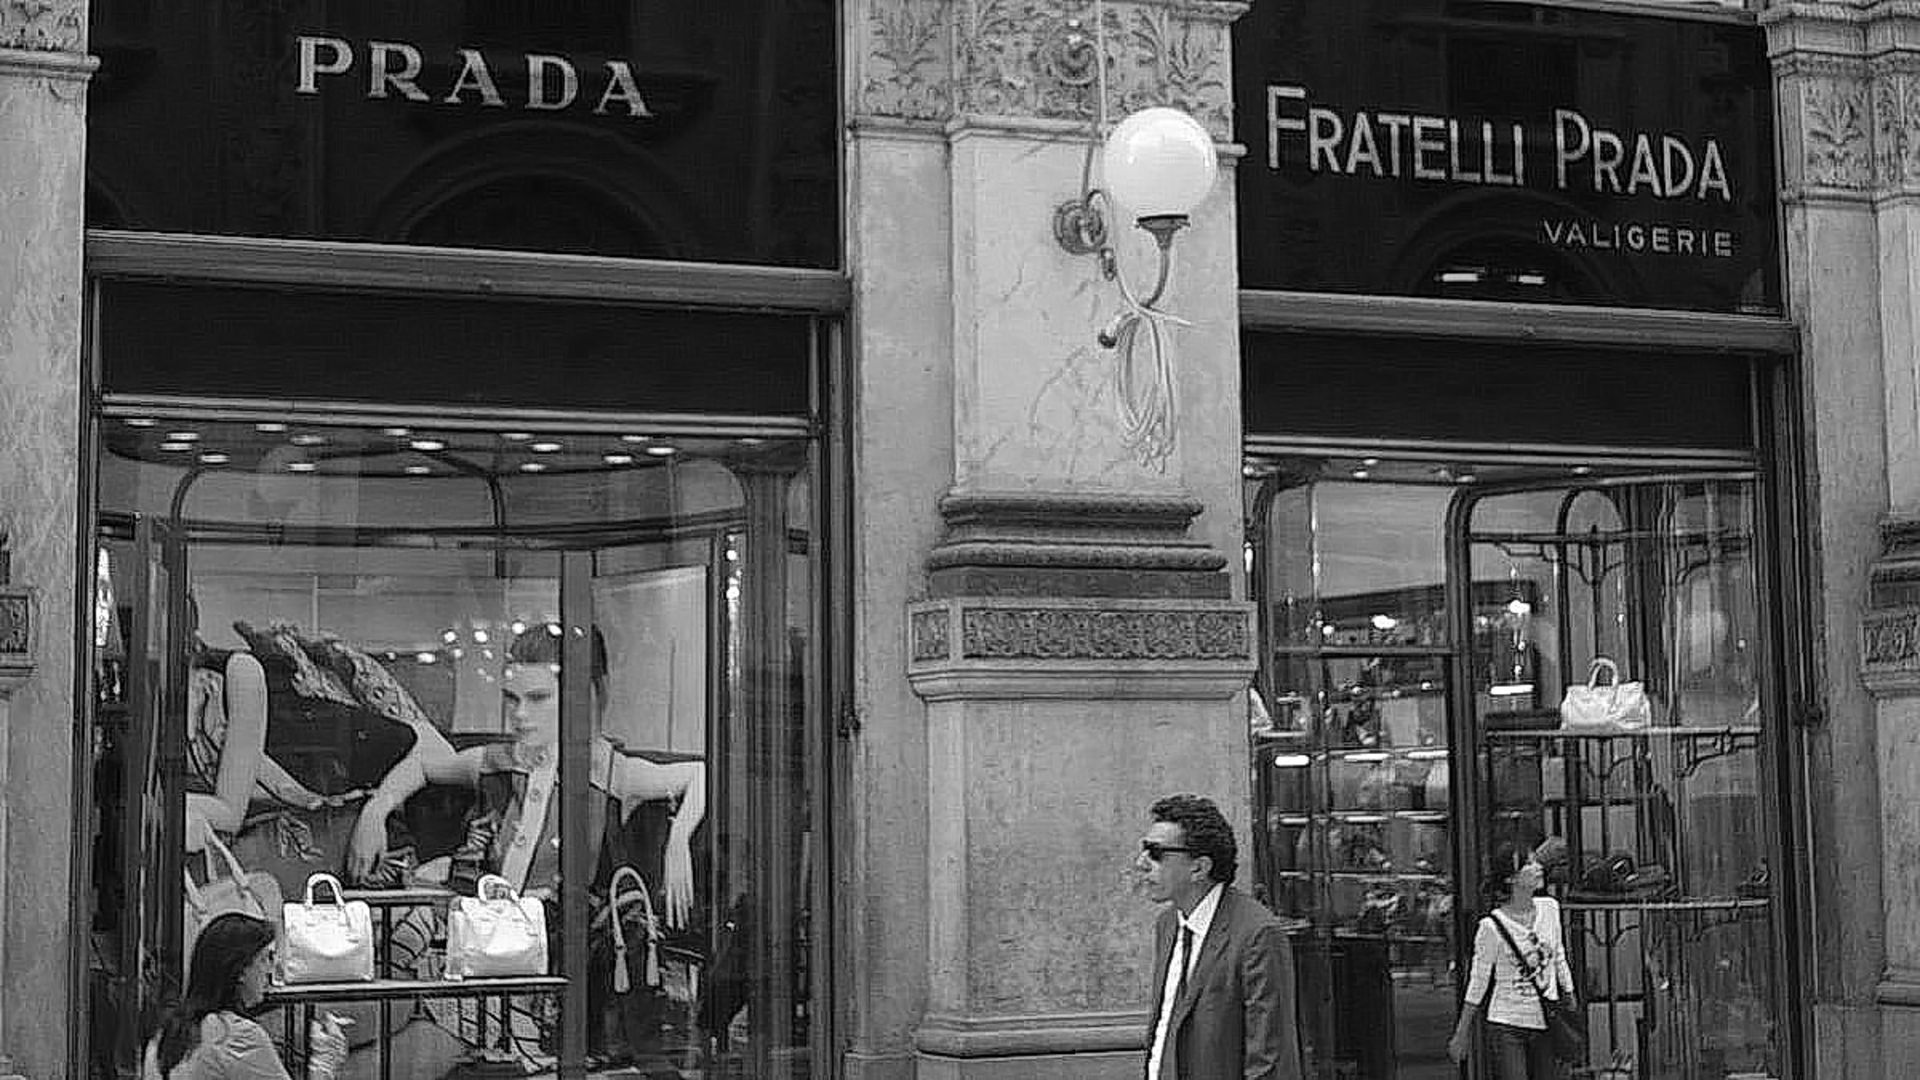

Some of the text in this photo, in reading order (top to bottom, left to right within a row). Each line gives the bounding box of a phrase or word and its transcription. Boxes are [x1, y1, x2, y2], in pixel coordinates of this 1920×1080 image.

[296, 36, 651, 117] PRADA
[1267, 86, 1732, 201] FRATELLI PRADA
[1543, 220, 1734, 257] VALIGERIE
